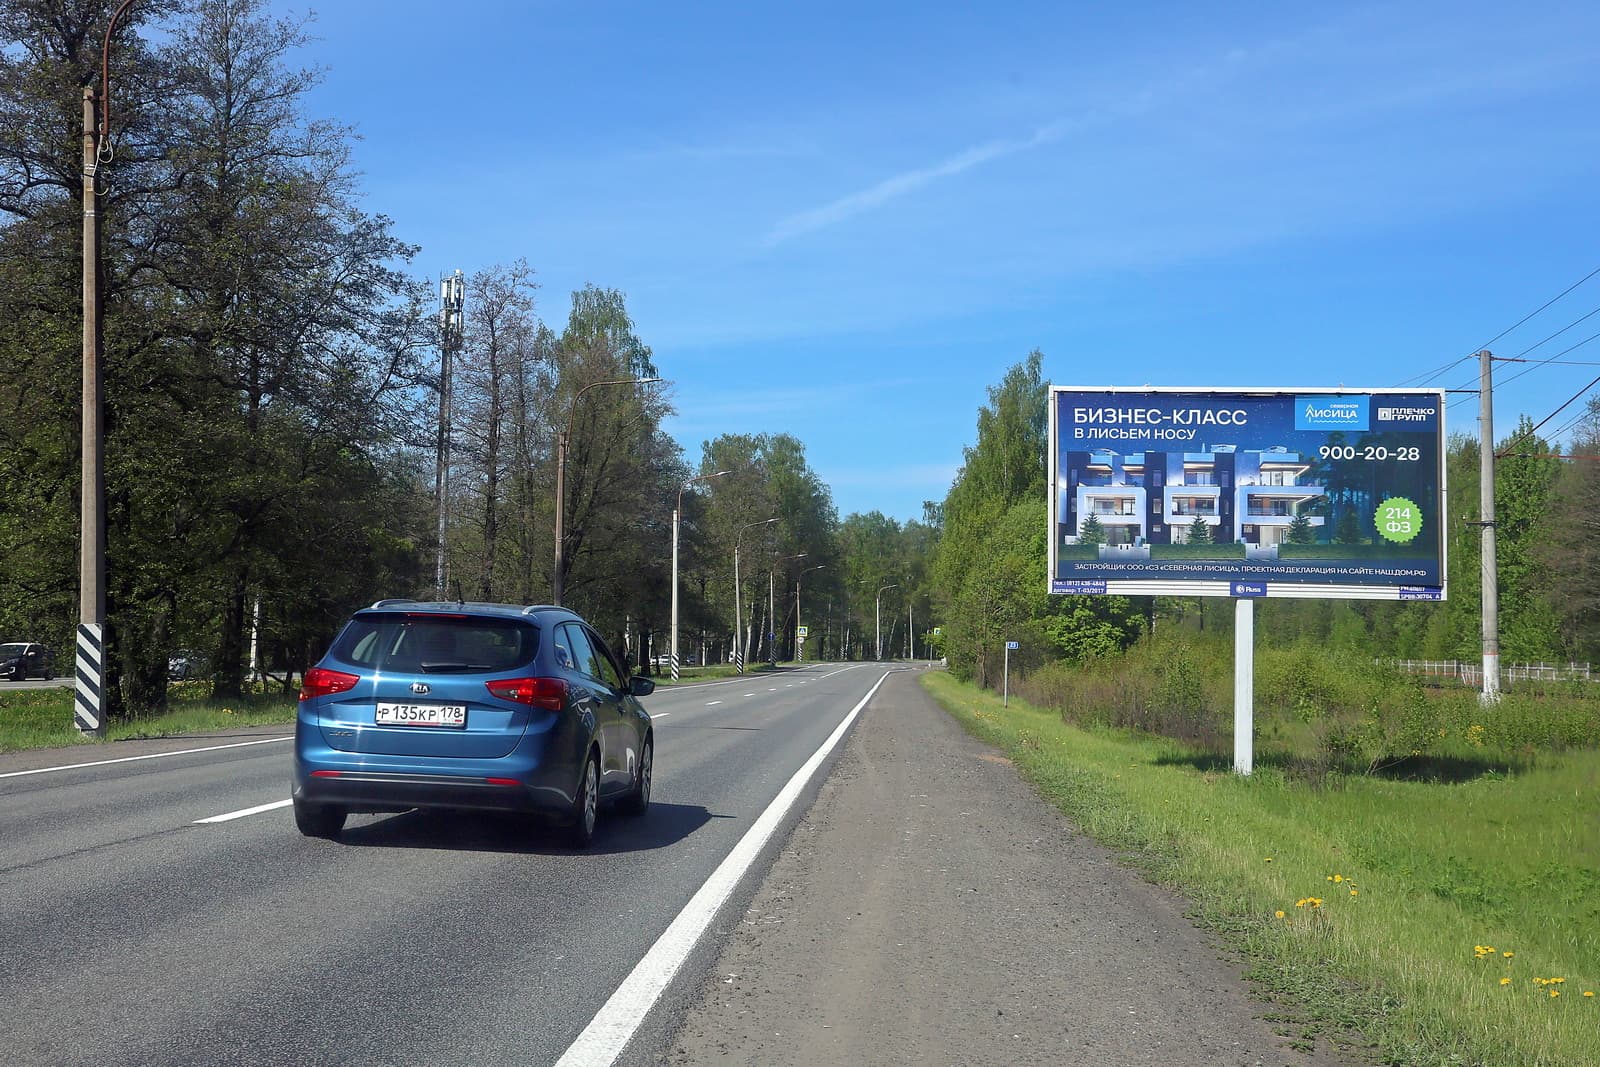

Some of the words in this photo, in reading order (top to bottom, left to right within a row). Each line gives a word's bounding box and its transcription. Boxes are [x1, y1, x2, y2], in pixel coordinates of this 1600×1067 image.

[1074, 408, 1247, 425] БИЗНЕС-КЛАСС
[1074, 429, 1084, 439] В
[1087, 428, 1150, 439] ЛИСЬЕМ
[1154, 429, 1196, 440] НОСУ
[1319, 446, 1420, 461] 900-20-28
[1385, 508, 1411, 519] 214
[1385, 521, 1411, 533] ФЗ
[1074, 563, 1126, 571] ЗАСТРОЙЩИК
[1285, 566, 1336, 574] ДЕКЛАРАЦИЯ
[1348, 566, 1374, 575] САЙТЕ
[412, 683, 428, 693] KIA
